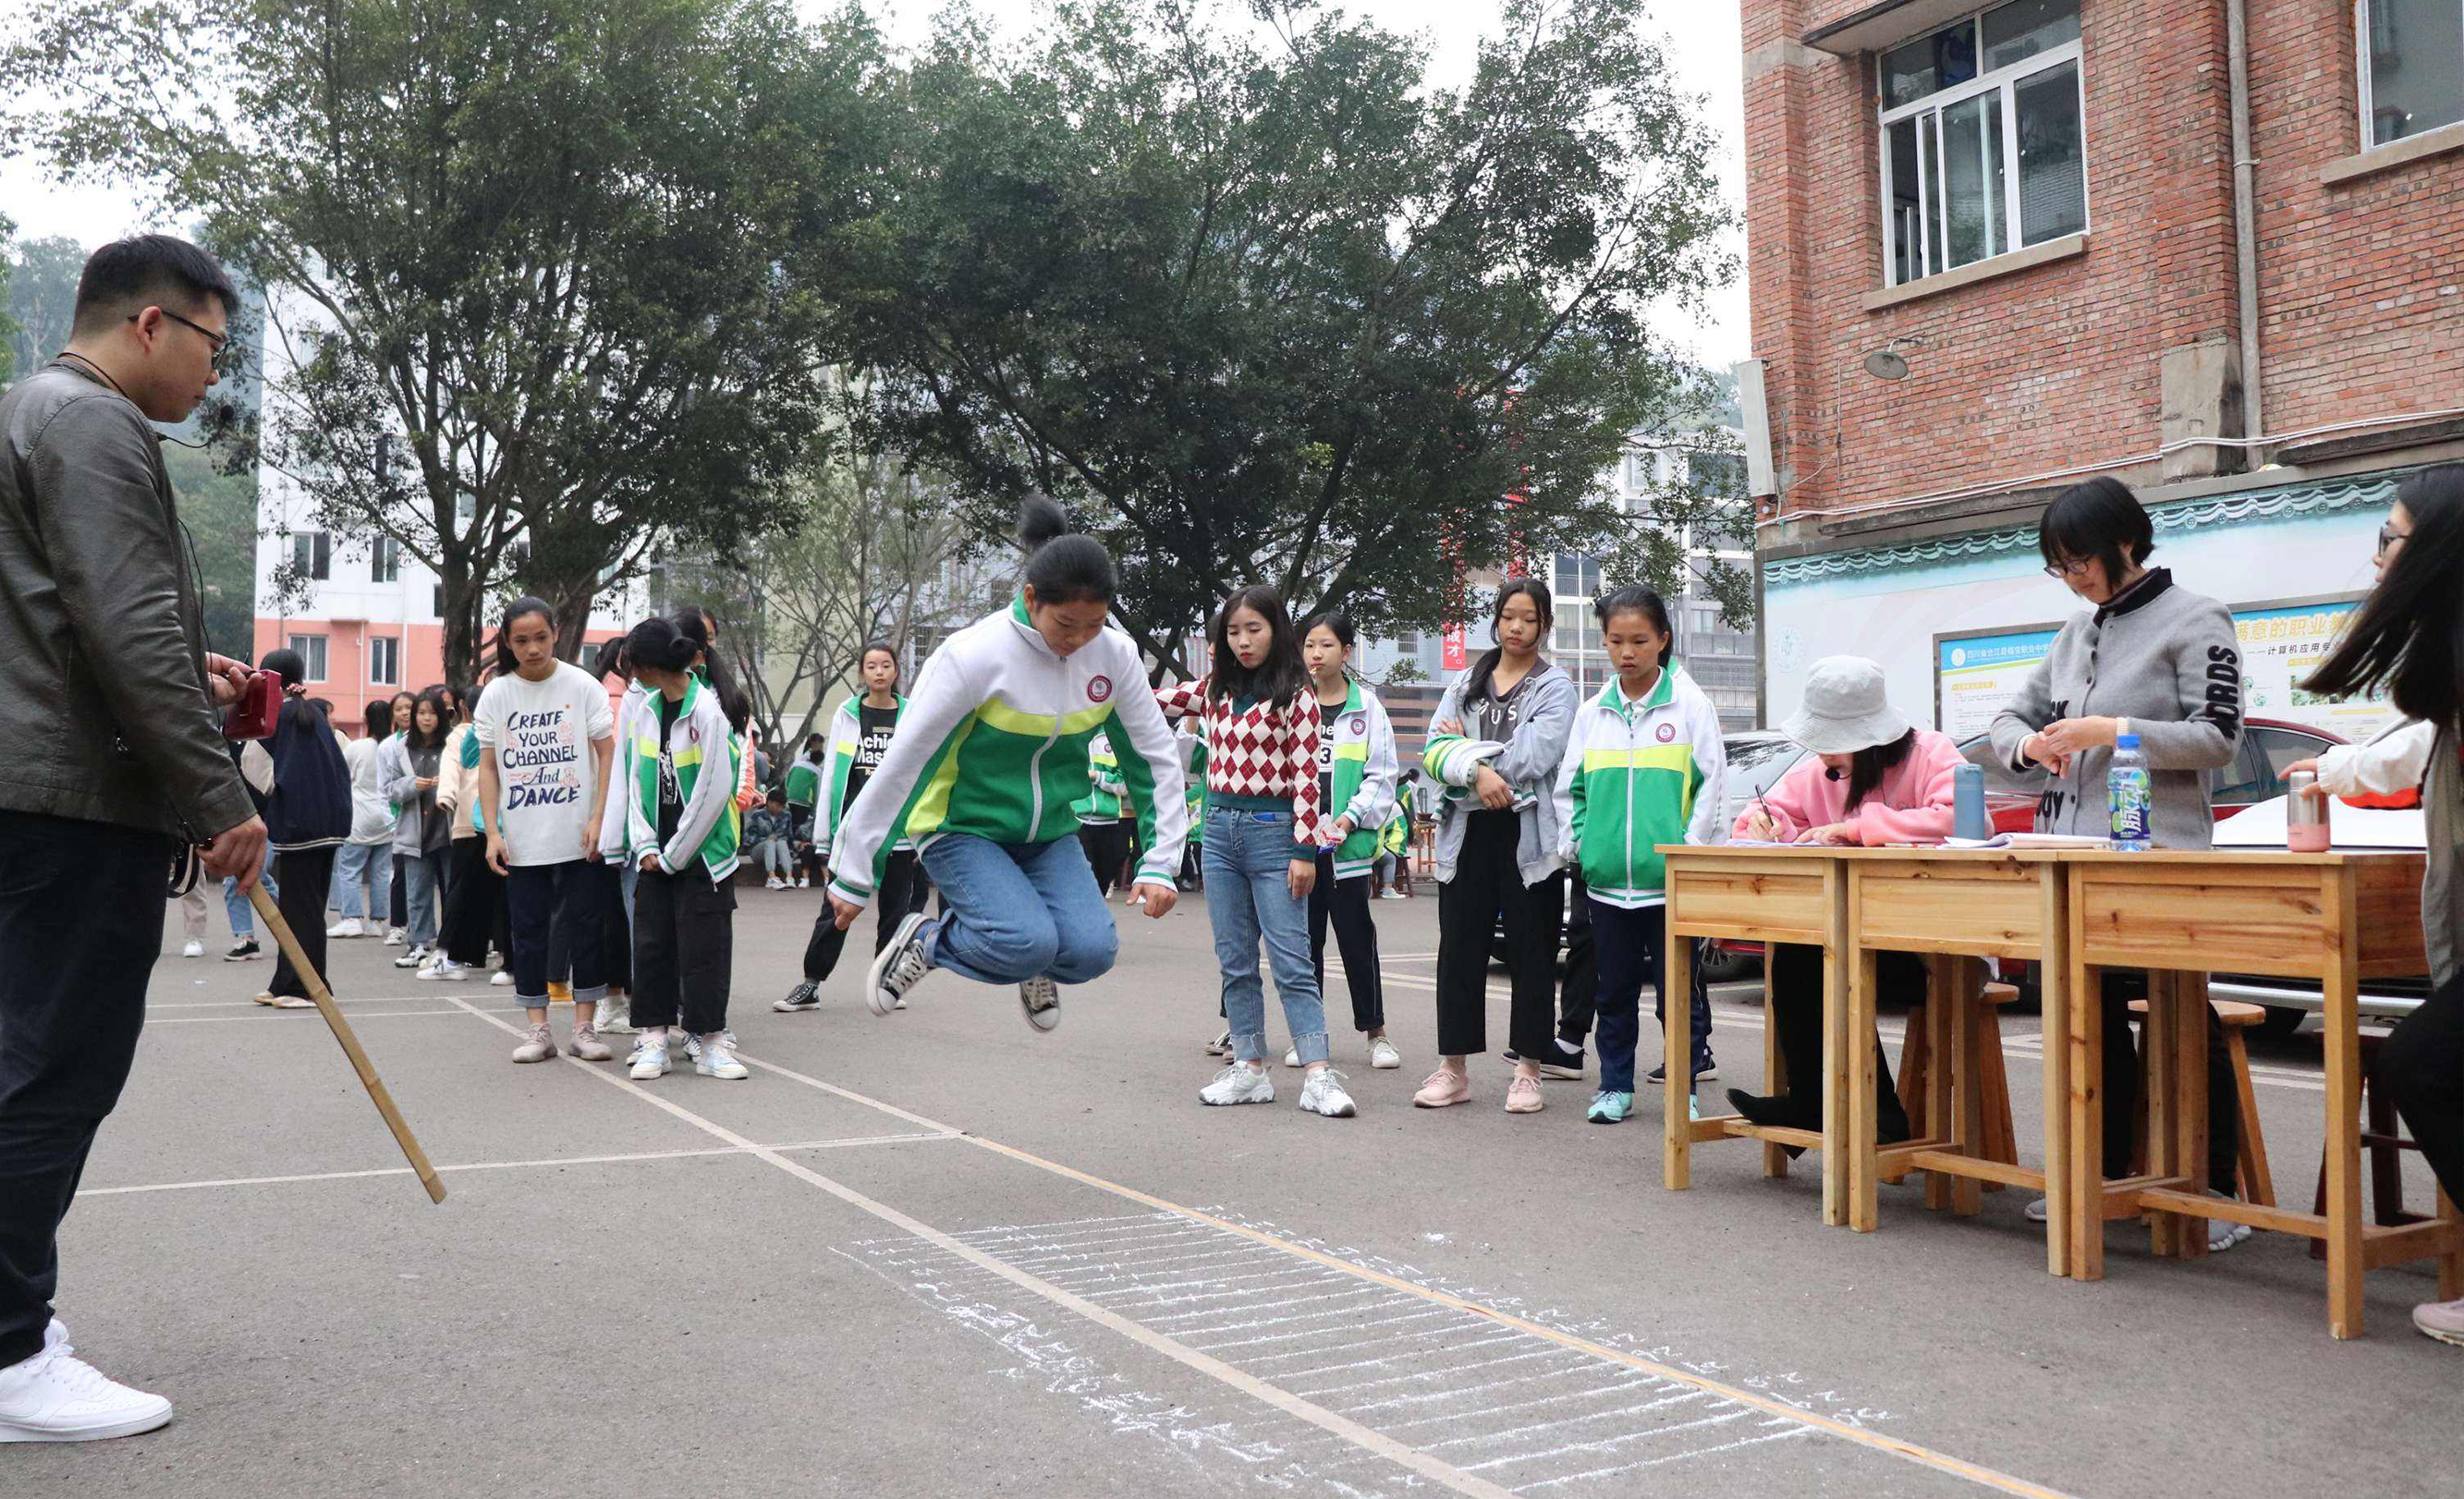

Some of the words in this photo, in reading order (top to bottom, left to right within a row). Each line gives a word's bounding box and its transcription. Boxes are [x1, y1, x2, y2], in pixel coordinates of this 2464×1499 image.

[507, 711, 564, 731] CREATE
[518, 731, 558, 748] YOUR
[503, 745, 578, 769] CHANNEL
[522, 766, 560, 786] And
[506, 784, 580, 810] DANCE
